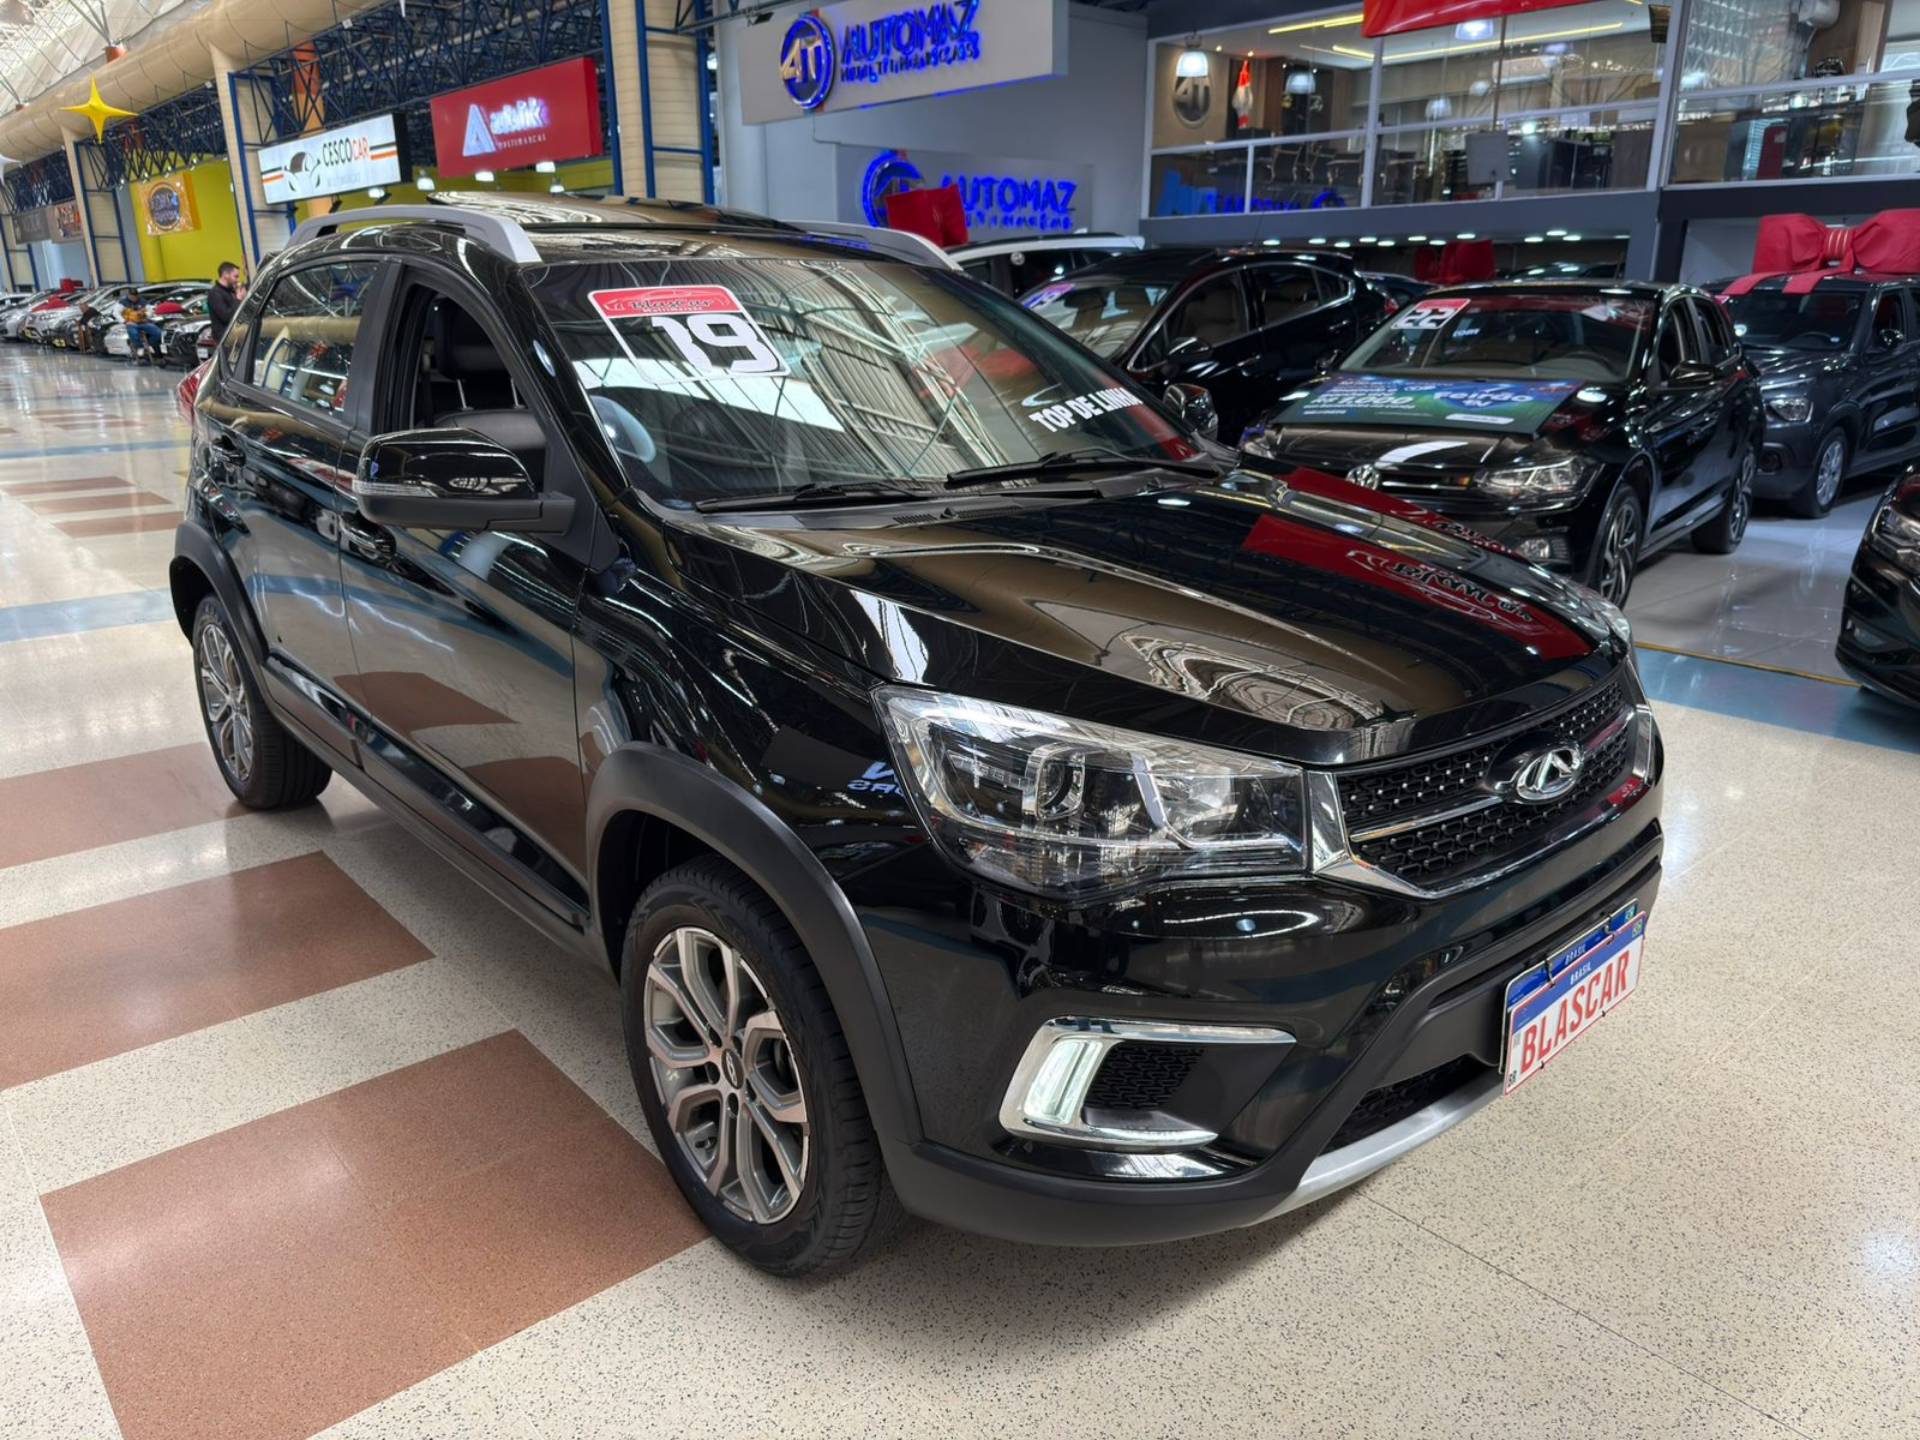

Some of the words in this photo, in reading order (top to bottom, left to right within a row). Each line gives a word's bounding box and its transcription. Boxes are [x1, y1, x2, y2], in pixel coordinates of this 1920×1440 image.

[841, 0, 979, 64] AUTOMAZ
[1401, 308, 1456, 328] 22
[652, 314, 779, 373] 19
[1029, 404, 1076, 432] TOP
[1065, 393, 1104, 420] DE
[1088, 387, 1143, 412] LINHA
[1564, 943, 1587, 965] BRASIL
[1570, 962, 1592, 985] BRASIL
[1520, 950, 1630, 1074] BLASCAR
